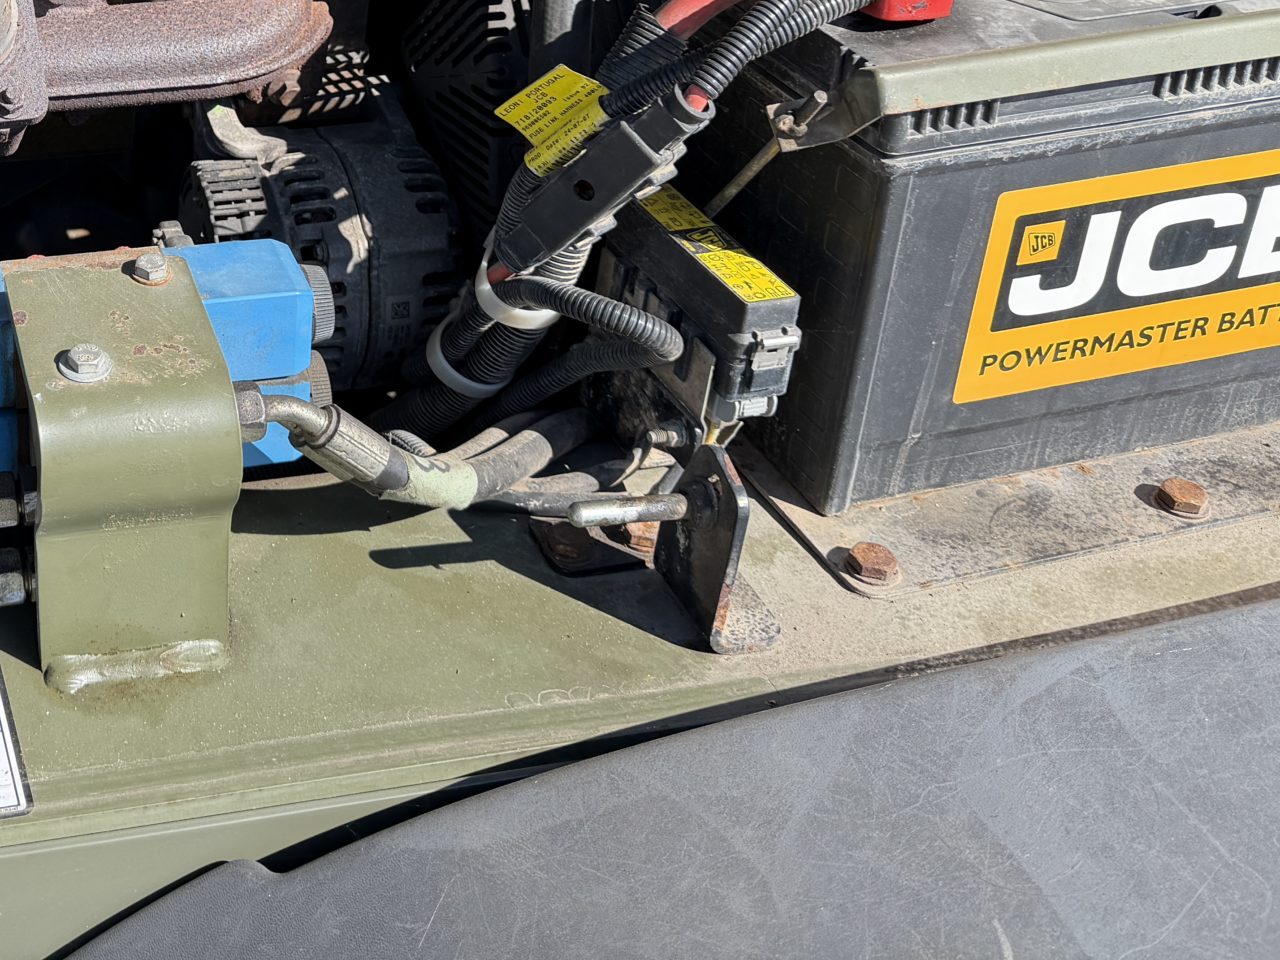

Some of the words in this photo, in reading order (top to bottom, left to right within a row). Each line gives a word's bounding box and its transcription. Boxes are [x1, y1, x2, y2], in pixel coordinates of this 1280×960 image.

[499, 100, 524, 117] LEONI
[525, 73, 566, 99] PORTUGAL
[533, 91, 549, 103] JCB
[1029, 233, 1055, 254] JCB
[979, 316, 1208, 376] POWERMASTER
